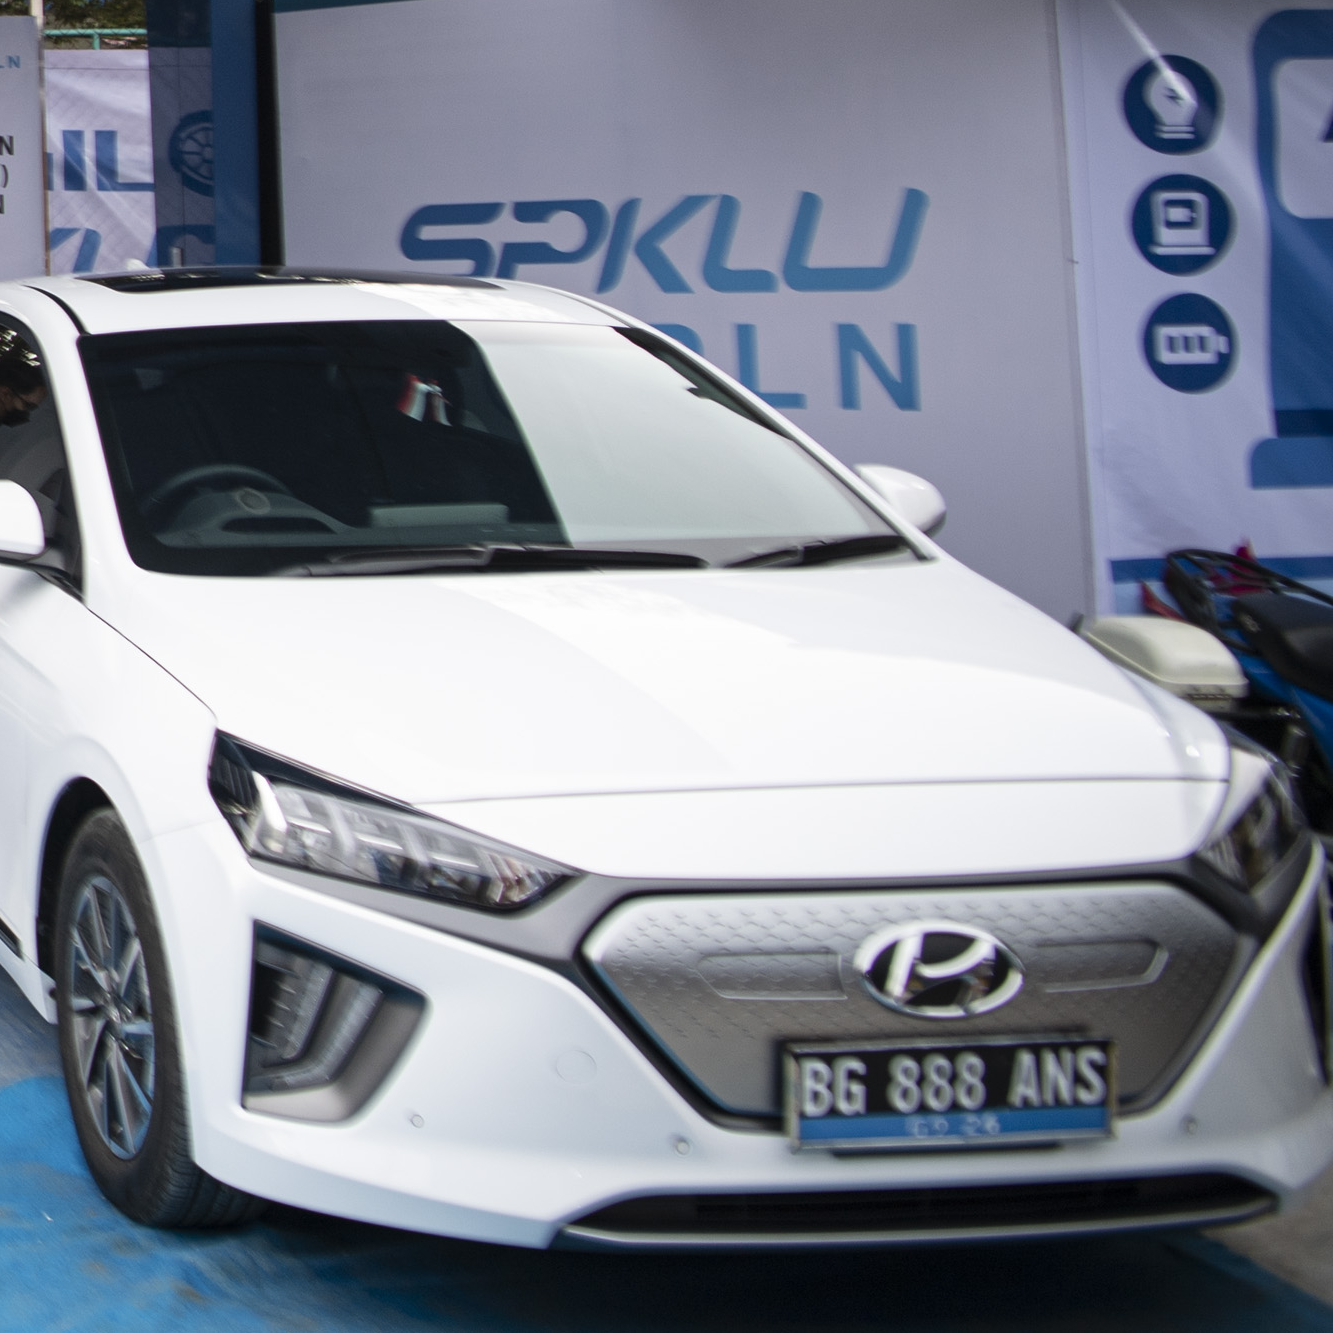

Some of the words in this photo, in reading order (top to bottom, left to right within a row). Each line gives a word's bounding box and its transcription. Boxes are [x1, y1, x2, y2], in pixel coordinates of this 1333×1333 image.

[399, 187, 930, 295] SPKLU
[799, 1057, 868, 1118] BG
[886, 1051, 987, 1113] 888
[1006, 1045, 1108, 1108] ANS
